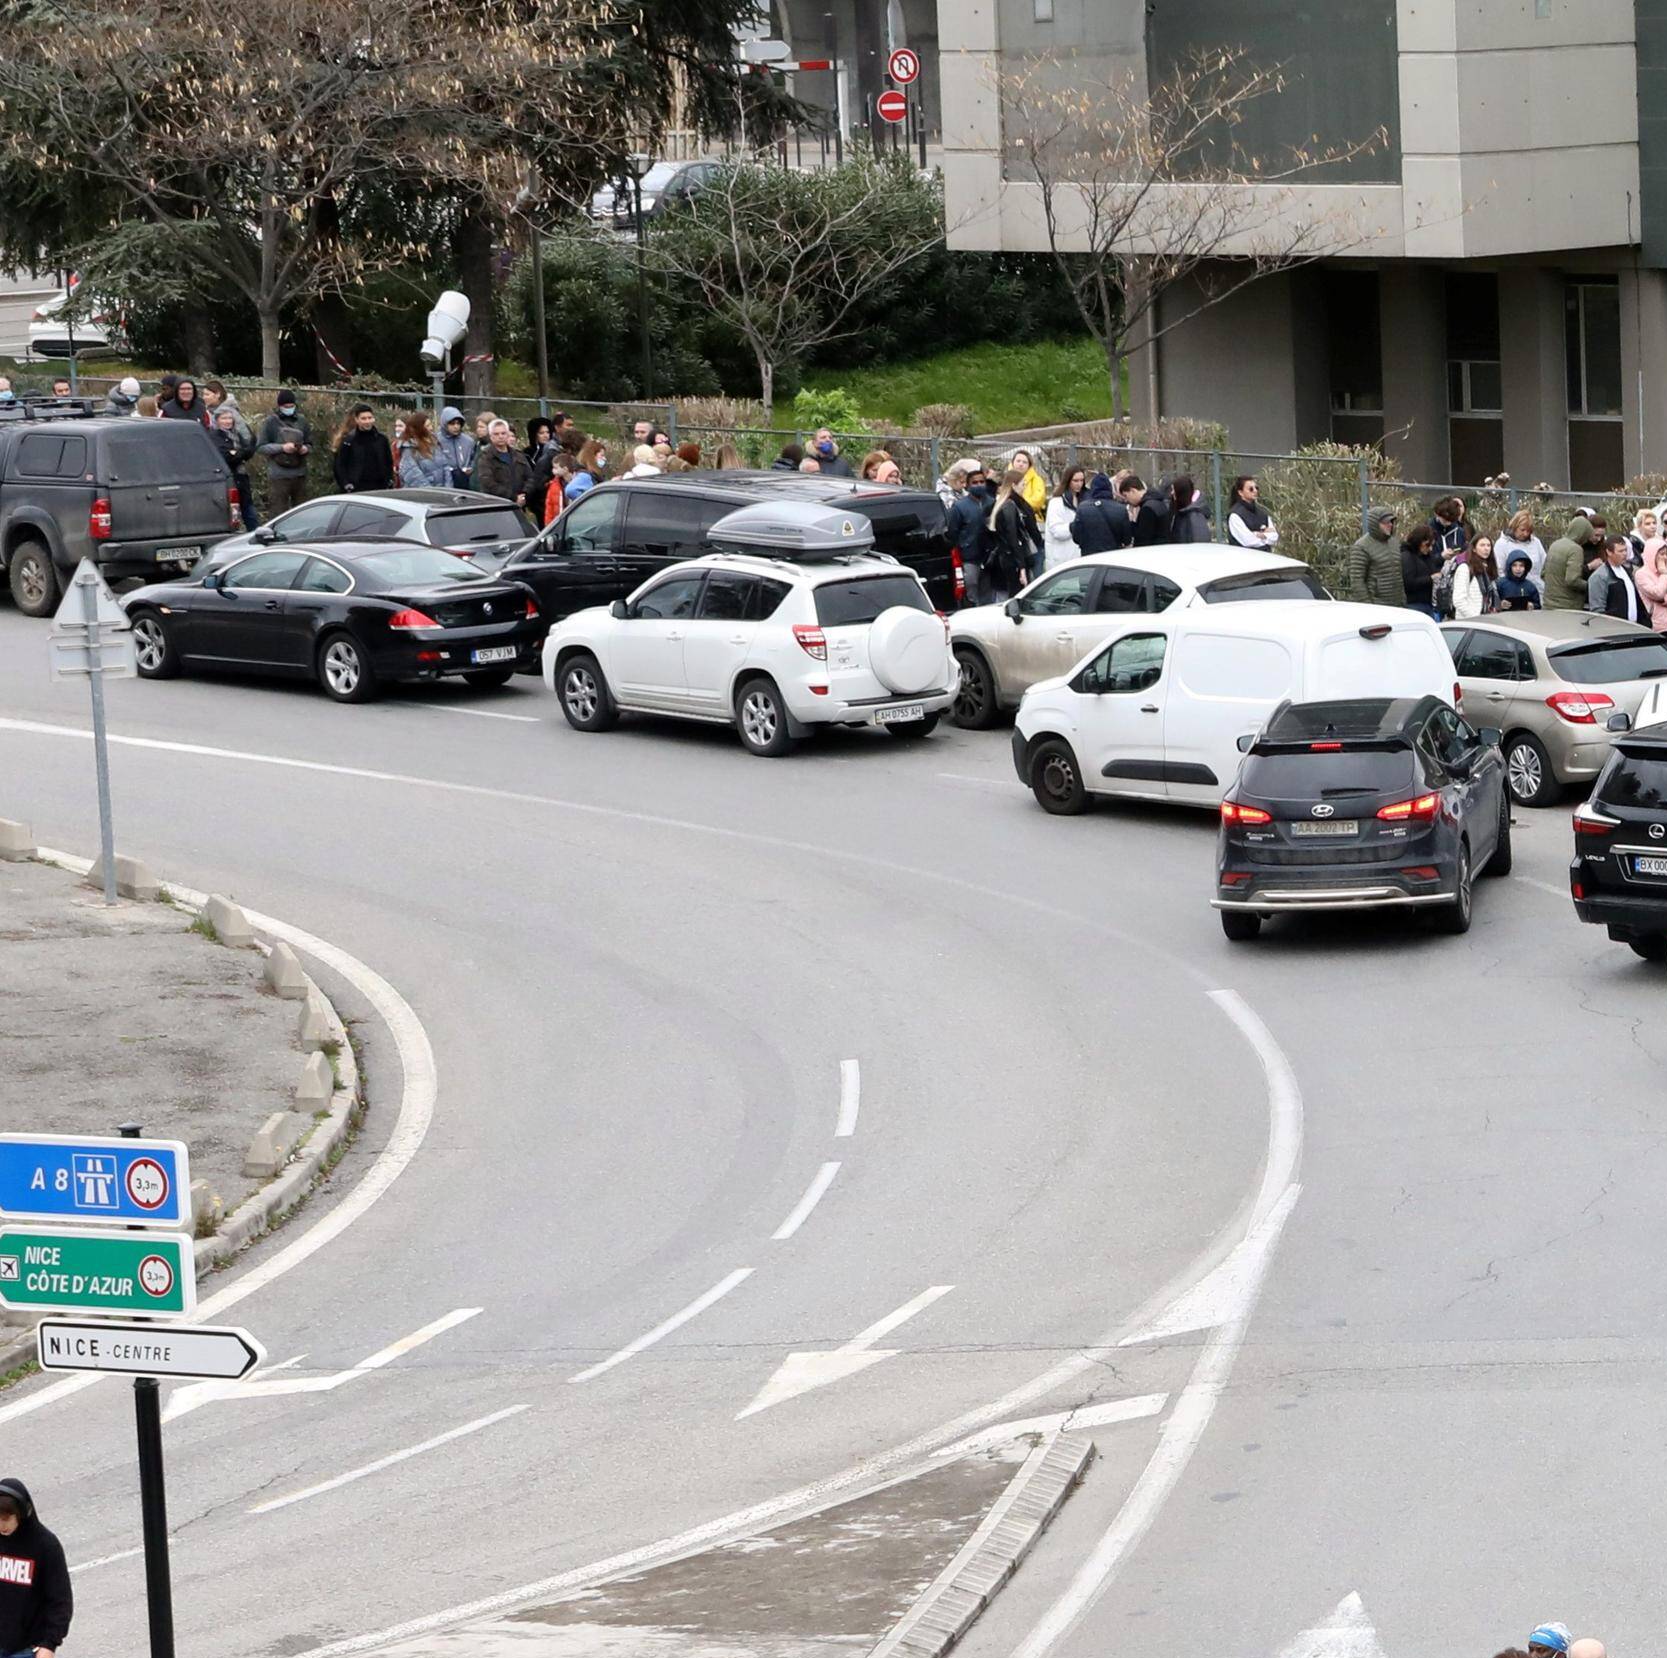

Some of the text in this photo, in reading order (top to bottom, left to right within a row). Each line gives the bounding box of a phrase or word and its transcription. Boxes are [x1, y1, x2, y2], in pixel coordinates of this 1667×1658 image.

[1297, 822, 1313, 833] AA
[31, 1167, 68, 1192] A 8
[24, 1246, 61, 1266] NICE
[27, 1268, 133, 1297] CÔTE D'AZUR
[49, 1337, 100, 1358] NICE
